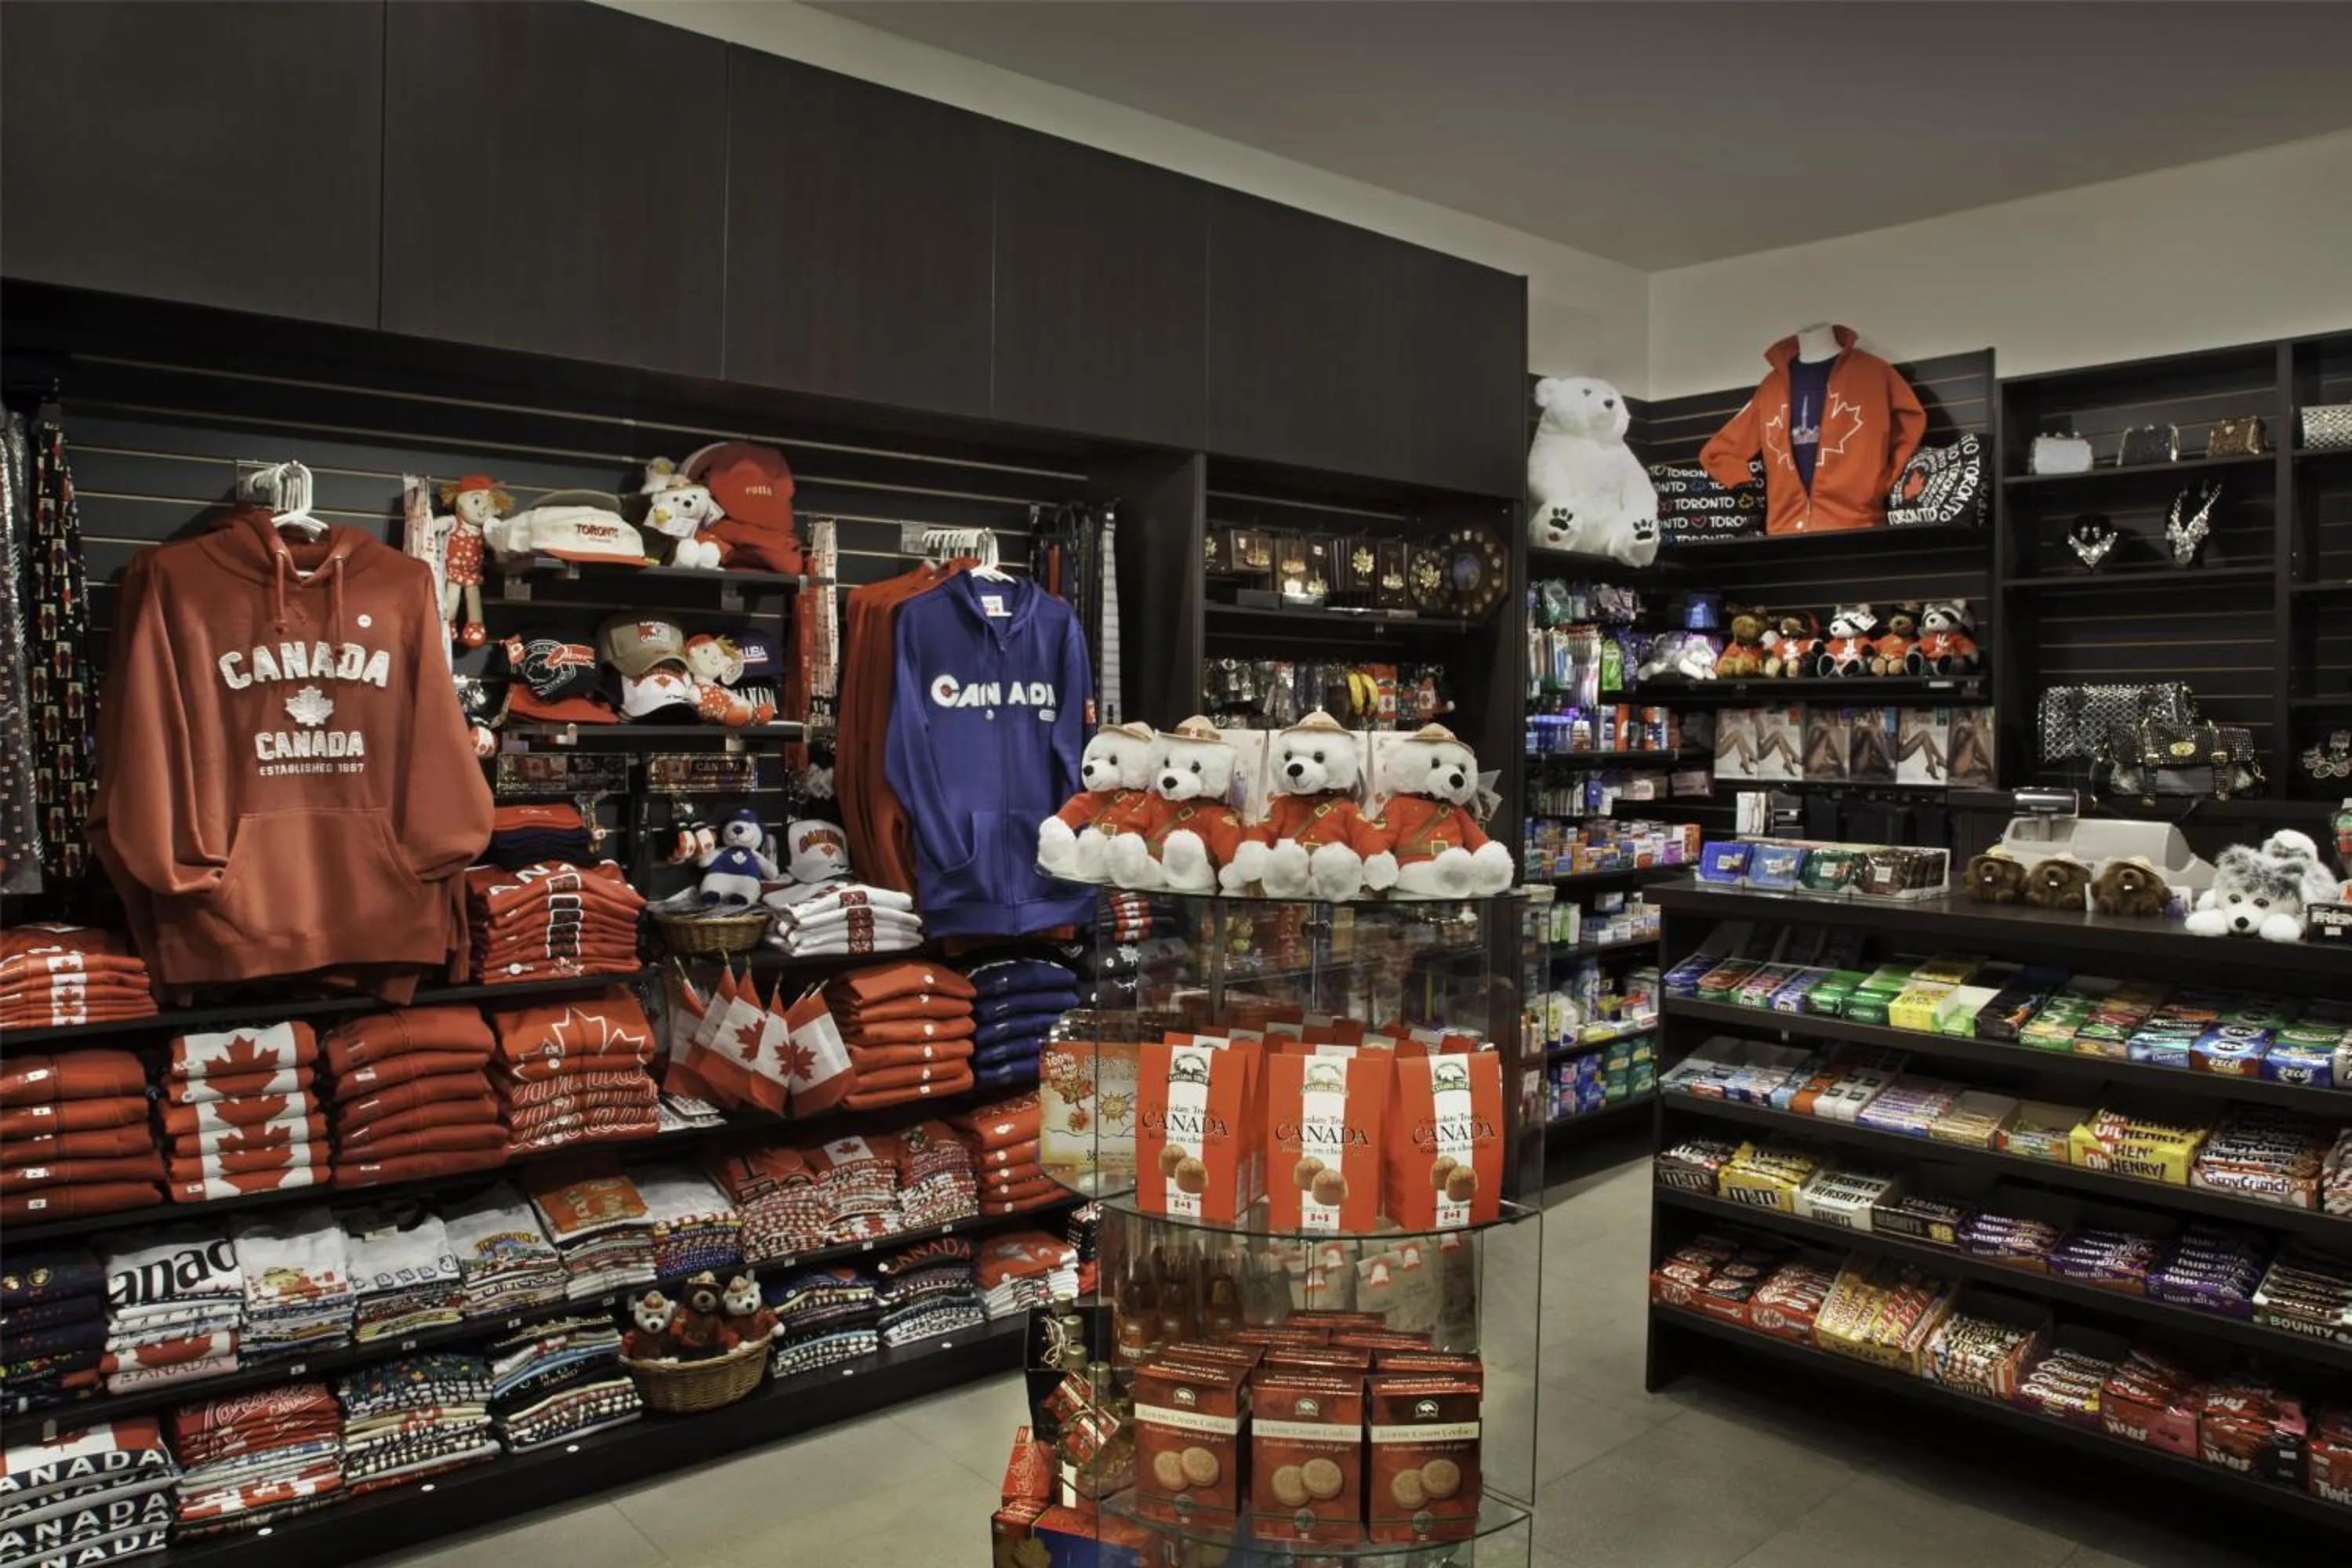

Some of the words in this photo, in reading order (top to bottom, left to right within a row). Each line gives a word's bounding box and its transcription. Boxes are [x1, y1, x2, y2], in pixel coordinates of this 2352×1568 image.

[1675, 496, 1735, 510] TORONTO
[1709, 515, 1748, 528] TORO
[1887, 506, 1938, 526] TORONTO
[218, 641, 390, 690] CANADA
[254, 730, 365, 760] CANADA
[1142, 1111, 1229, 1137] CANADA
[1276, 1123, 1369, 1146] CANADA
[1412, 1121, 1497, 1145] CANADA
[2085, 1152, 2109, 1170] Oh
[2111, 1159, 2167, 1180] HENRY!
[2270, 1316, 2334, 1338] BOUNTY
